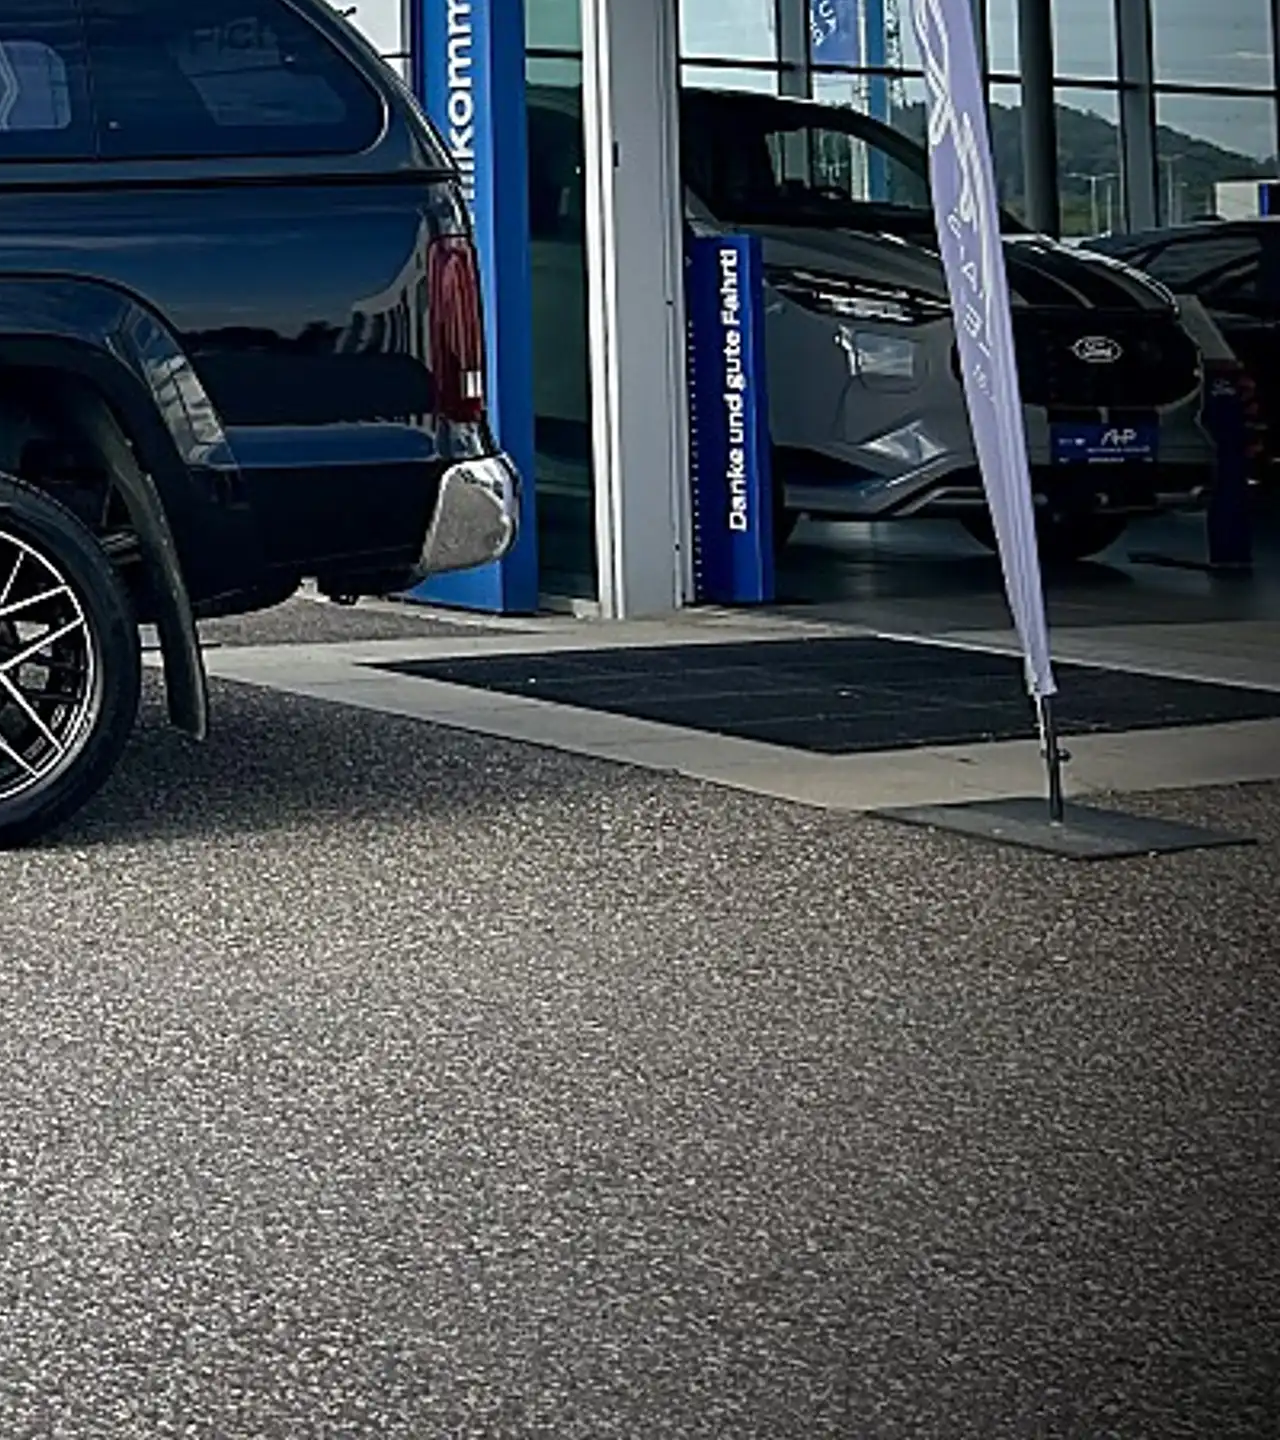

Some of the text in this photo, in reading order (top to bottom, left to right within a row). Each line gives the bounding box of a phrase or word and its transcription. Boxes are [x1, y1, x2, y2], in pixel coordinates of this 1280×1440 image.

[723, 329, 746, 391] gute
[723, 393, 744, 443] und
[726, 447, 747, 532] Danke
